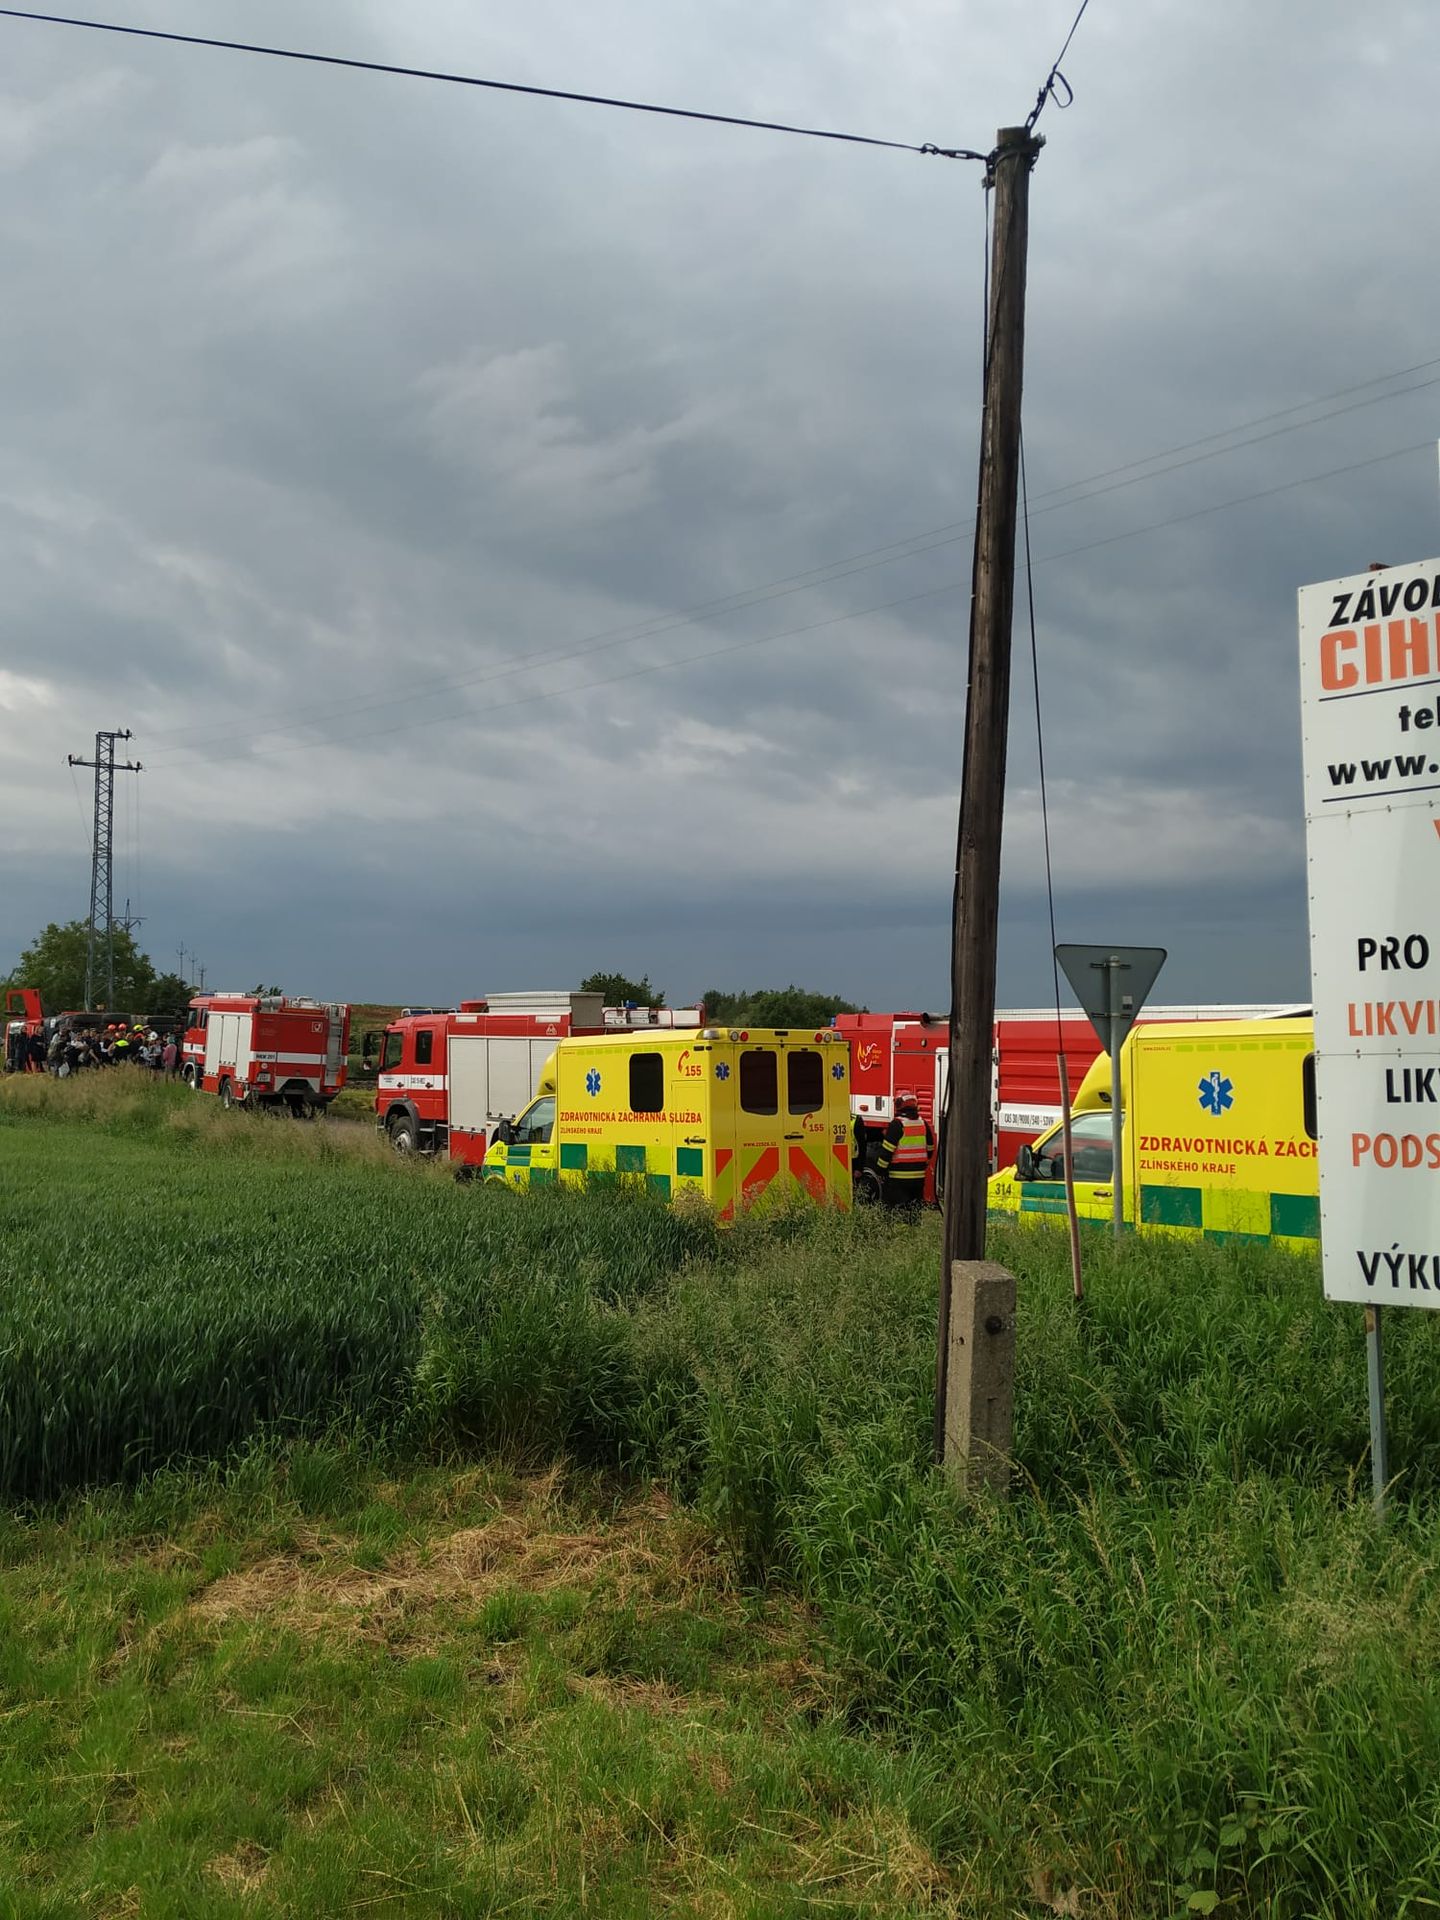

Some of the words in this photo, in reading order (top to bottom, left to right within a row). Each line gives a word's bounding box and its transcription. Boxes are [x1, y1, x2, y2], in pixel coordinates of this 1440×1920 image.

[1320, 612, 1440, 690] CIH
[1327, 755, 1439, 786] www.
[1357, 934, 1430, 971] PRO
[1348, 1000, 1440, 1036] LIKVI
[685, 1065, 702, 1077] 155
[1386, 1068, 1440, 1103] LIK
[560, 1109, 616, 1122] ZDRAVOTNICKÁ
[669, 1109, 702, 1124] SLUŽBA
[809, 1123, 824, 1132] 155
[832, 1125, 847, 1135] 313
[1139, 1135, 1269, 1156] ZDRAVOTNICKÁ
[1352, 1133, 1440, 1169] PODS
[1139, 1158, 1199, 1172] ZLÍNSKÉHO
[1202, 1162, 1237, 1174] KRAJE
[995, 1183, 1012, 1195] 314
